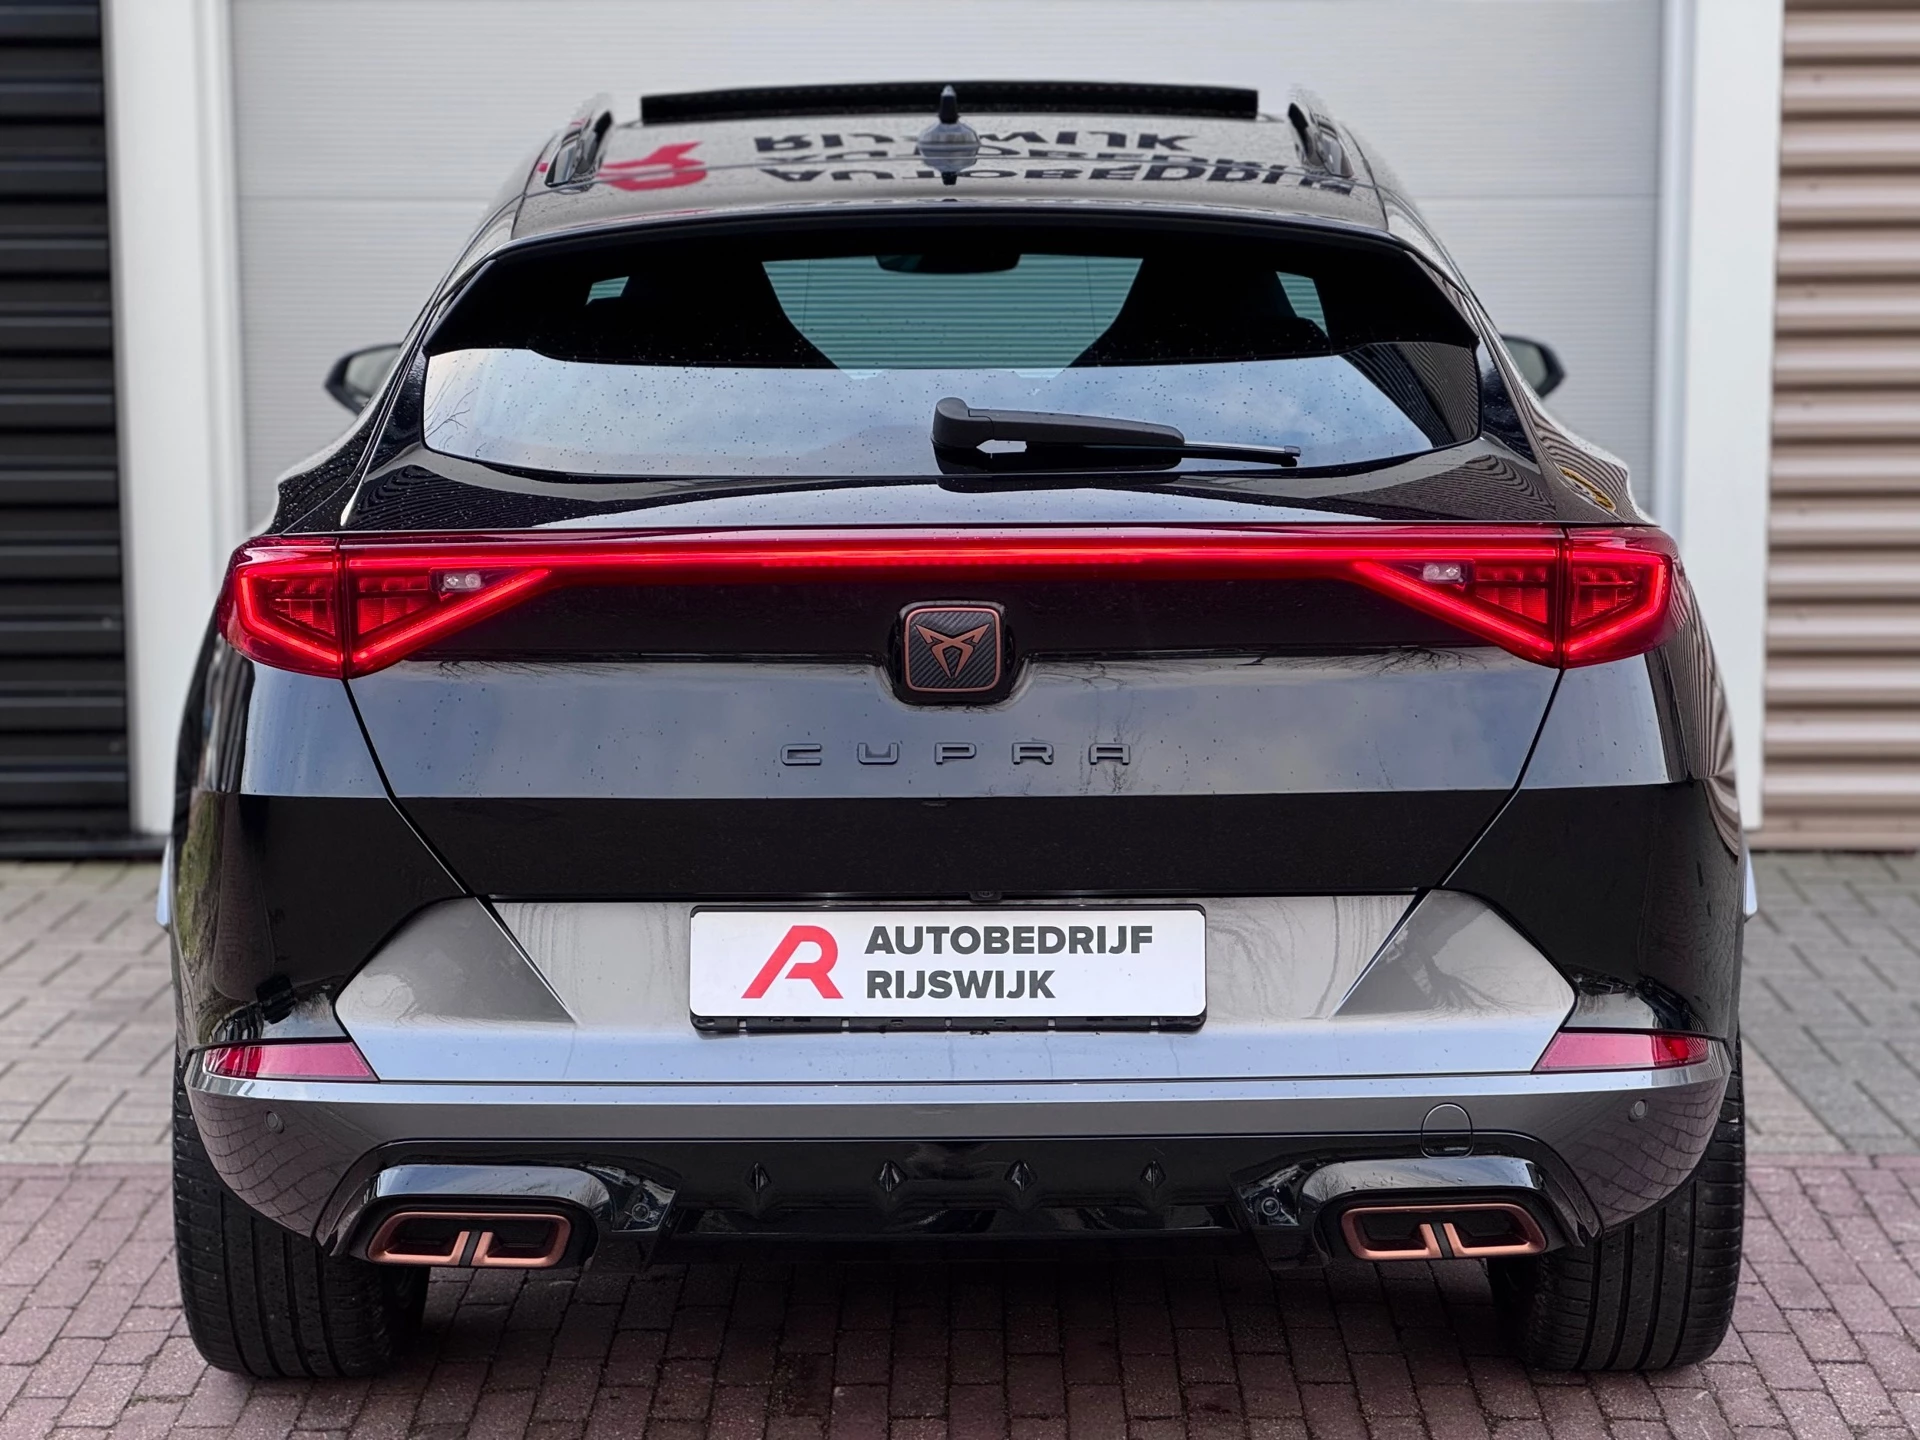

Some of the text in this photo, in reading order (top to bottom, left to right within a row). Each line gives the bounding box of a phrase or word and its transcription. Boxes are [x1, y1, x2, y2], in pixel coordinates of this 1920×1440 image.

[780, 742, 1131, 767] CUPRA
[864, 924, 1153, 956] AUTOBEDRIJF
[866, 969, 1056, 1000] RIJSWIJK
